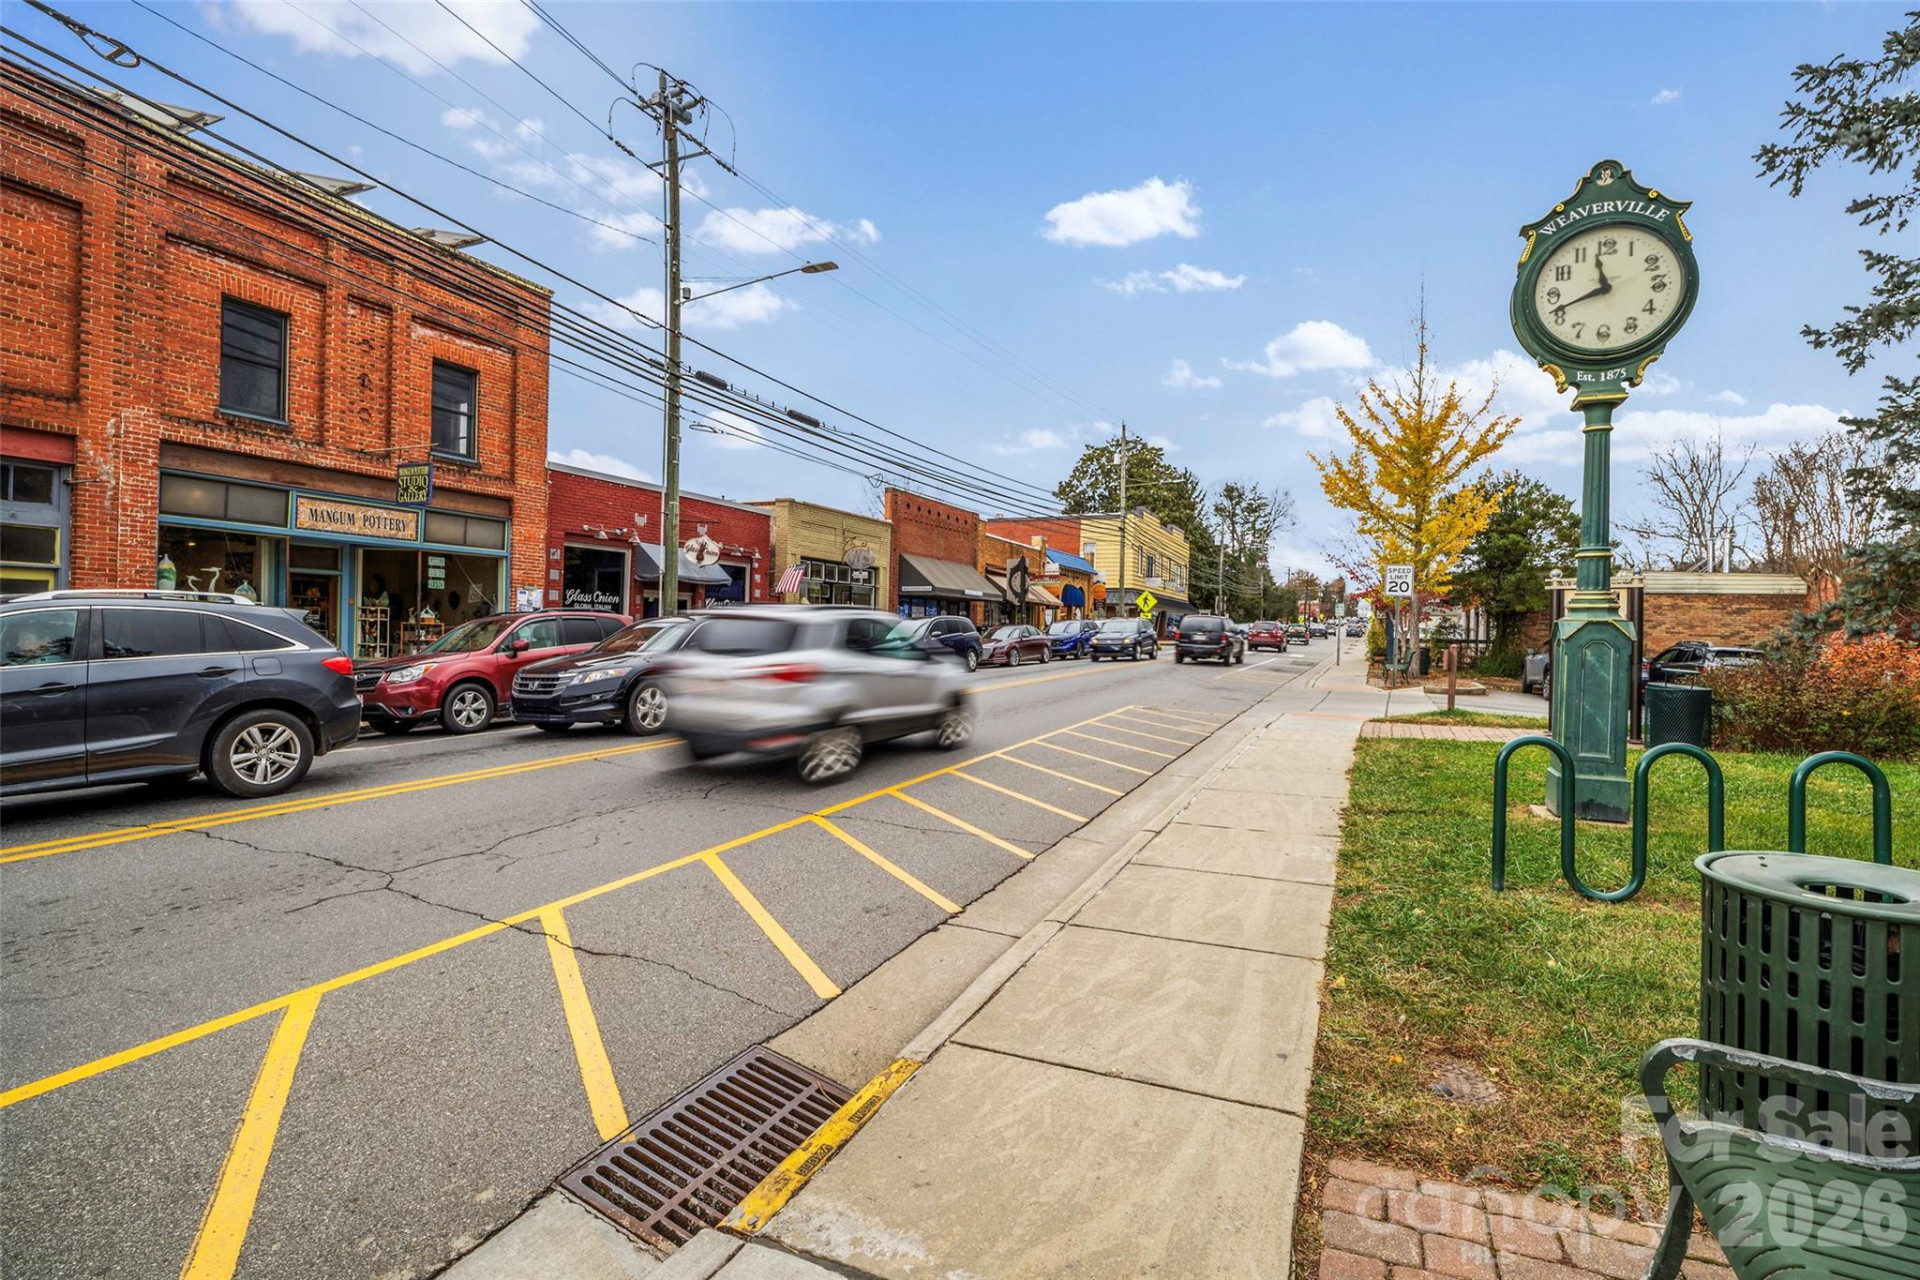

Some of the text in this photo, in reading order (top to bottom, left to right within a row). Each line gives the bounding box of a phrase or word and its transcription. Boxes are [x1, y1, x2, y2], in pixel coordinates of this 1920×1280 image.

[1539, 200, 1669, 237] WEAVERVILLE
[1576, 368, 1626, 382] Est. 1875
[399, 475, 428, 489] STUDIO
[398, 489, 427, 502] GALLERY
[308, 508, 406, 532] MANGUM POTTERY
[1388, 581, 1410, 593] 20
[564, 588, 620, 605] Glass Onion
